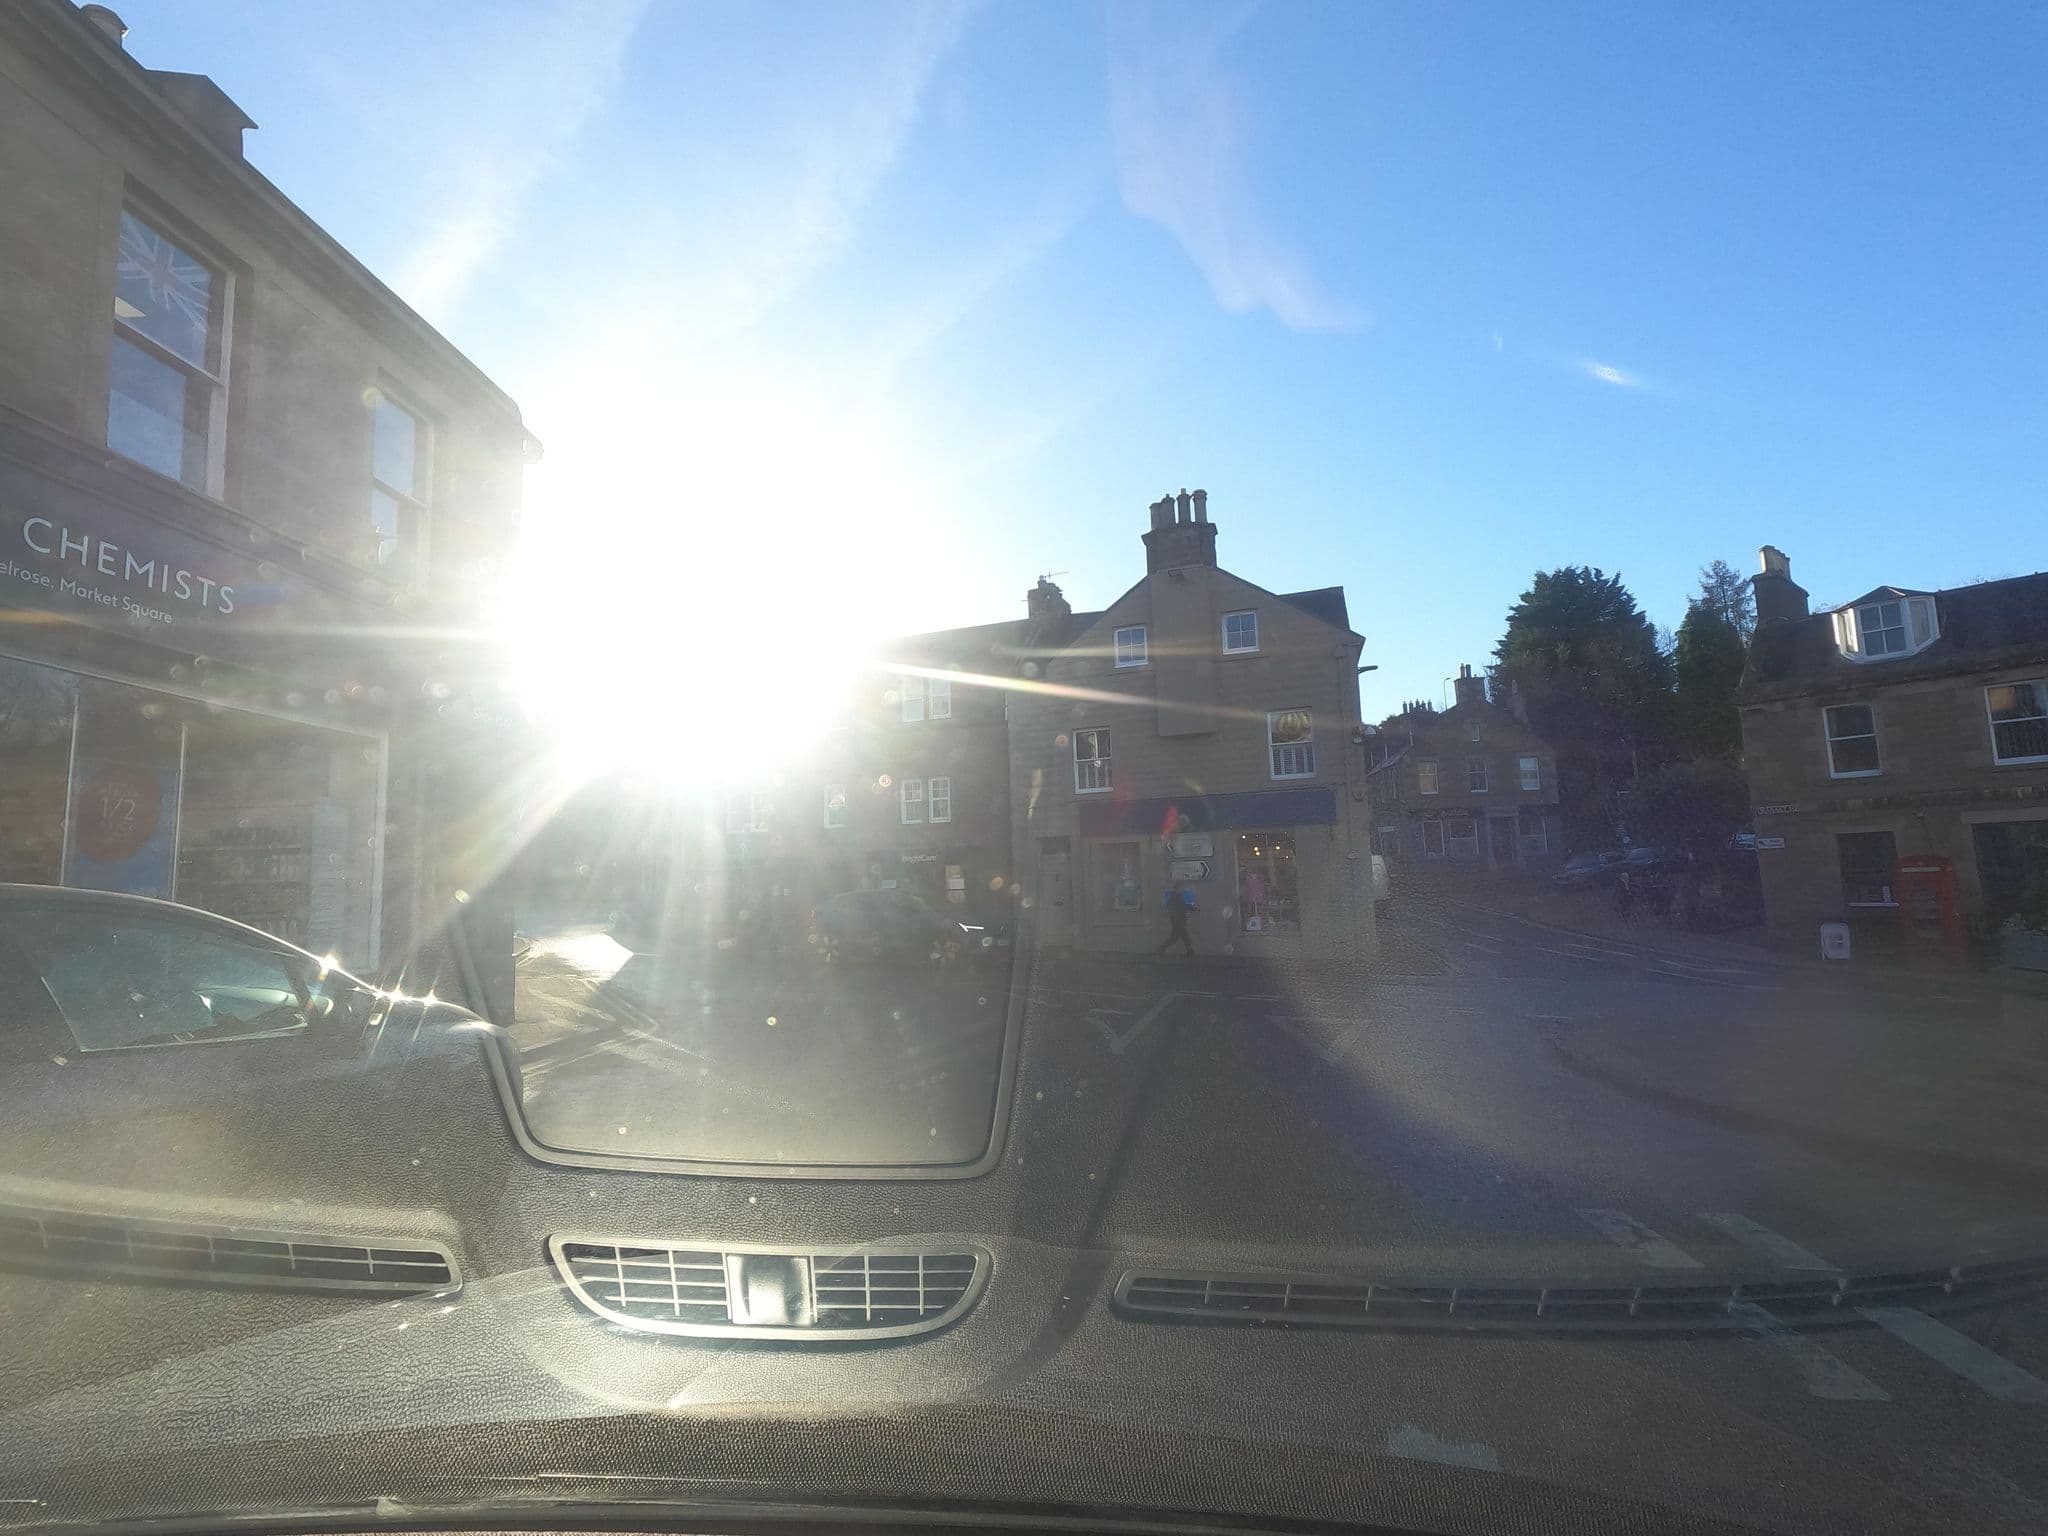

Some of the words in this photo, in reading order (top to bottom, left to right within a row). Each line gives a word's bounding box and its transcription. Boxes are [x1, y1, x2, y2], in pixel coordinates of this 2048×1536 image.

[23, 517, 235, 614] CHEMISTS
[59, 576, 118, 607] Market
[121, 596, 173, 623] Square
